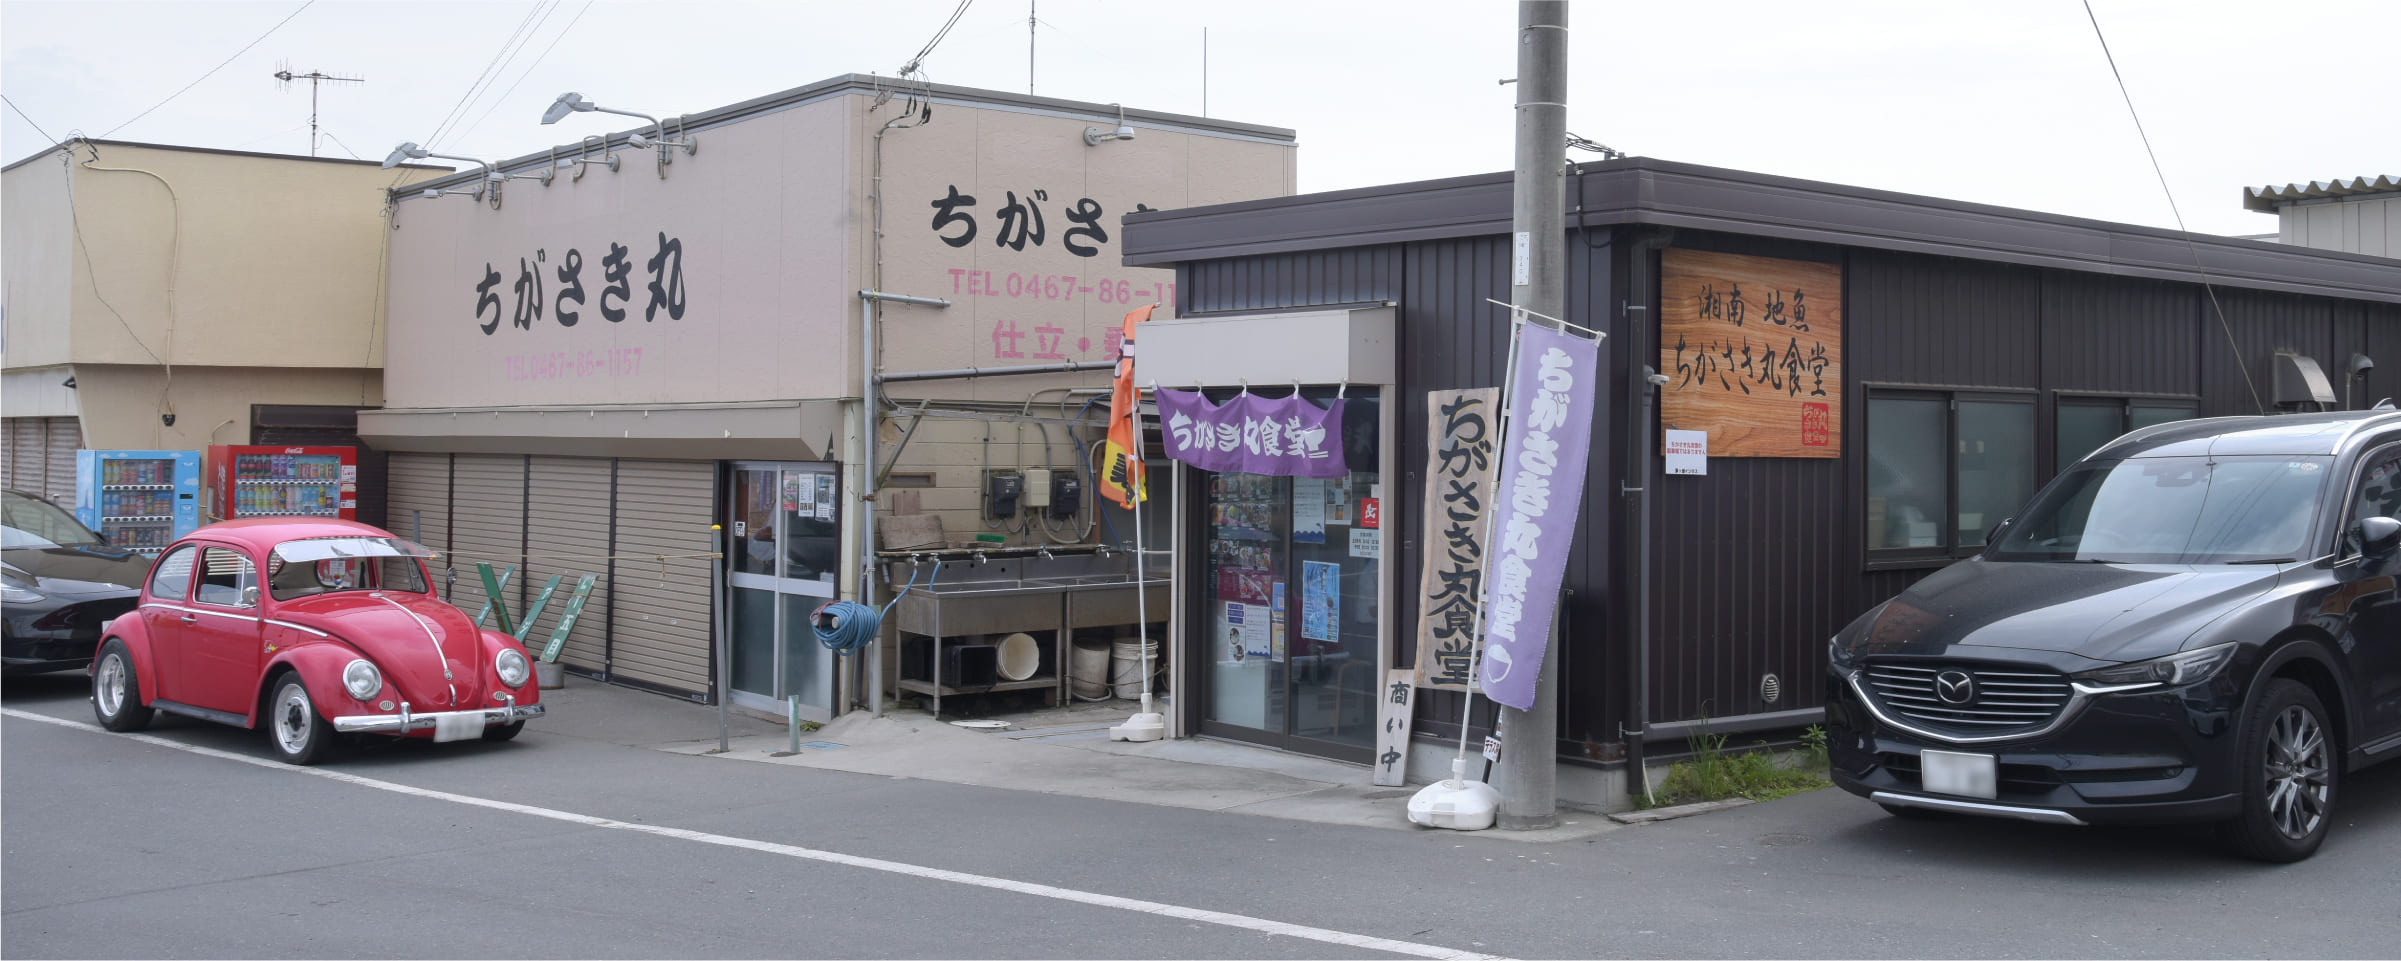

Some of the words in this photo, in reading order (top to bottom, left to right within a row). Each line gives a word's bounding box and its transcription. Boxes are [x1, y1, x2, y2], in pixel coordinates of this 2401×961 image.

[931, 184, 1158, 258] ちがさ
[475, 231, 686, 336] ちがさき丸
[948, 268, 999, 297] TEL
[1698, 283, 1745, 327] 湘南
[1763, 288, 1809, 332] 地魚
[1674, 332, 1830, 398] ちがさき丸食堂
[1491, 347, 1574, 644] ちがさき丸食堂
[1427, 394, 1492, 686] ちがさき丸食堂
[1381, 681, 1410, 773] 商い中
